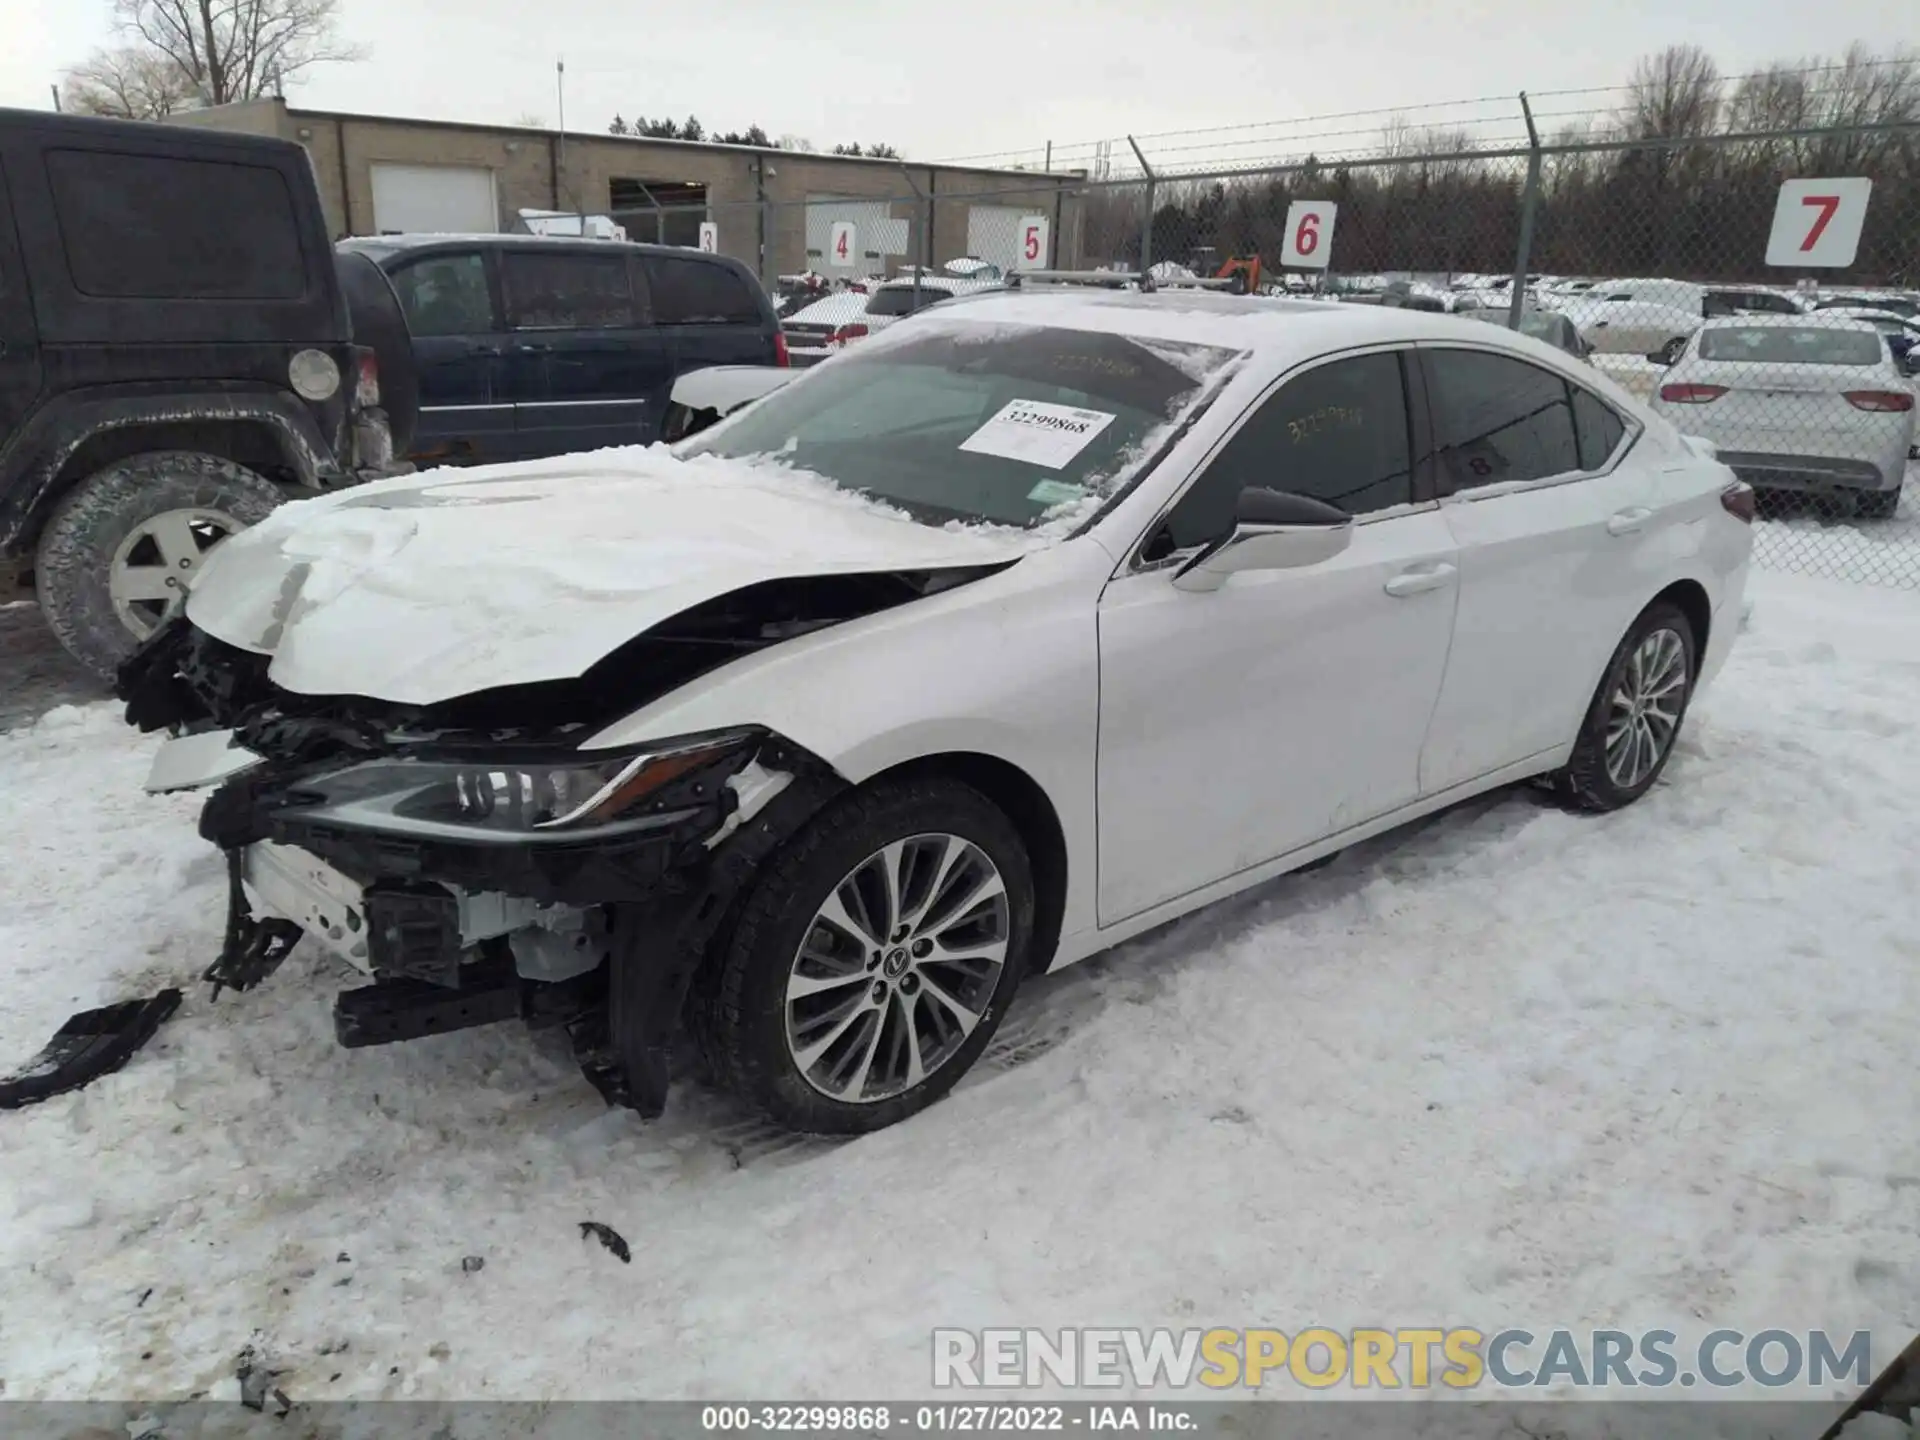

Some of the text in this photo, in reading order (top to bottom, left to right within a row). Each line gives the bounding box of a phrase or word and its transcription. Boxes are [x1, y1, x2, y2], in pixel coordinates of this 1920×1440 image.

[1295, 213, 1321, 257] 6
[1800, 194, 1840, 252] 7
[703, 229, 713, 252] 3
[835, 230, 848, 259] 4
[1024, 226, 1040, 260] 5
[1003, 411, 1089, 434] 32299868
